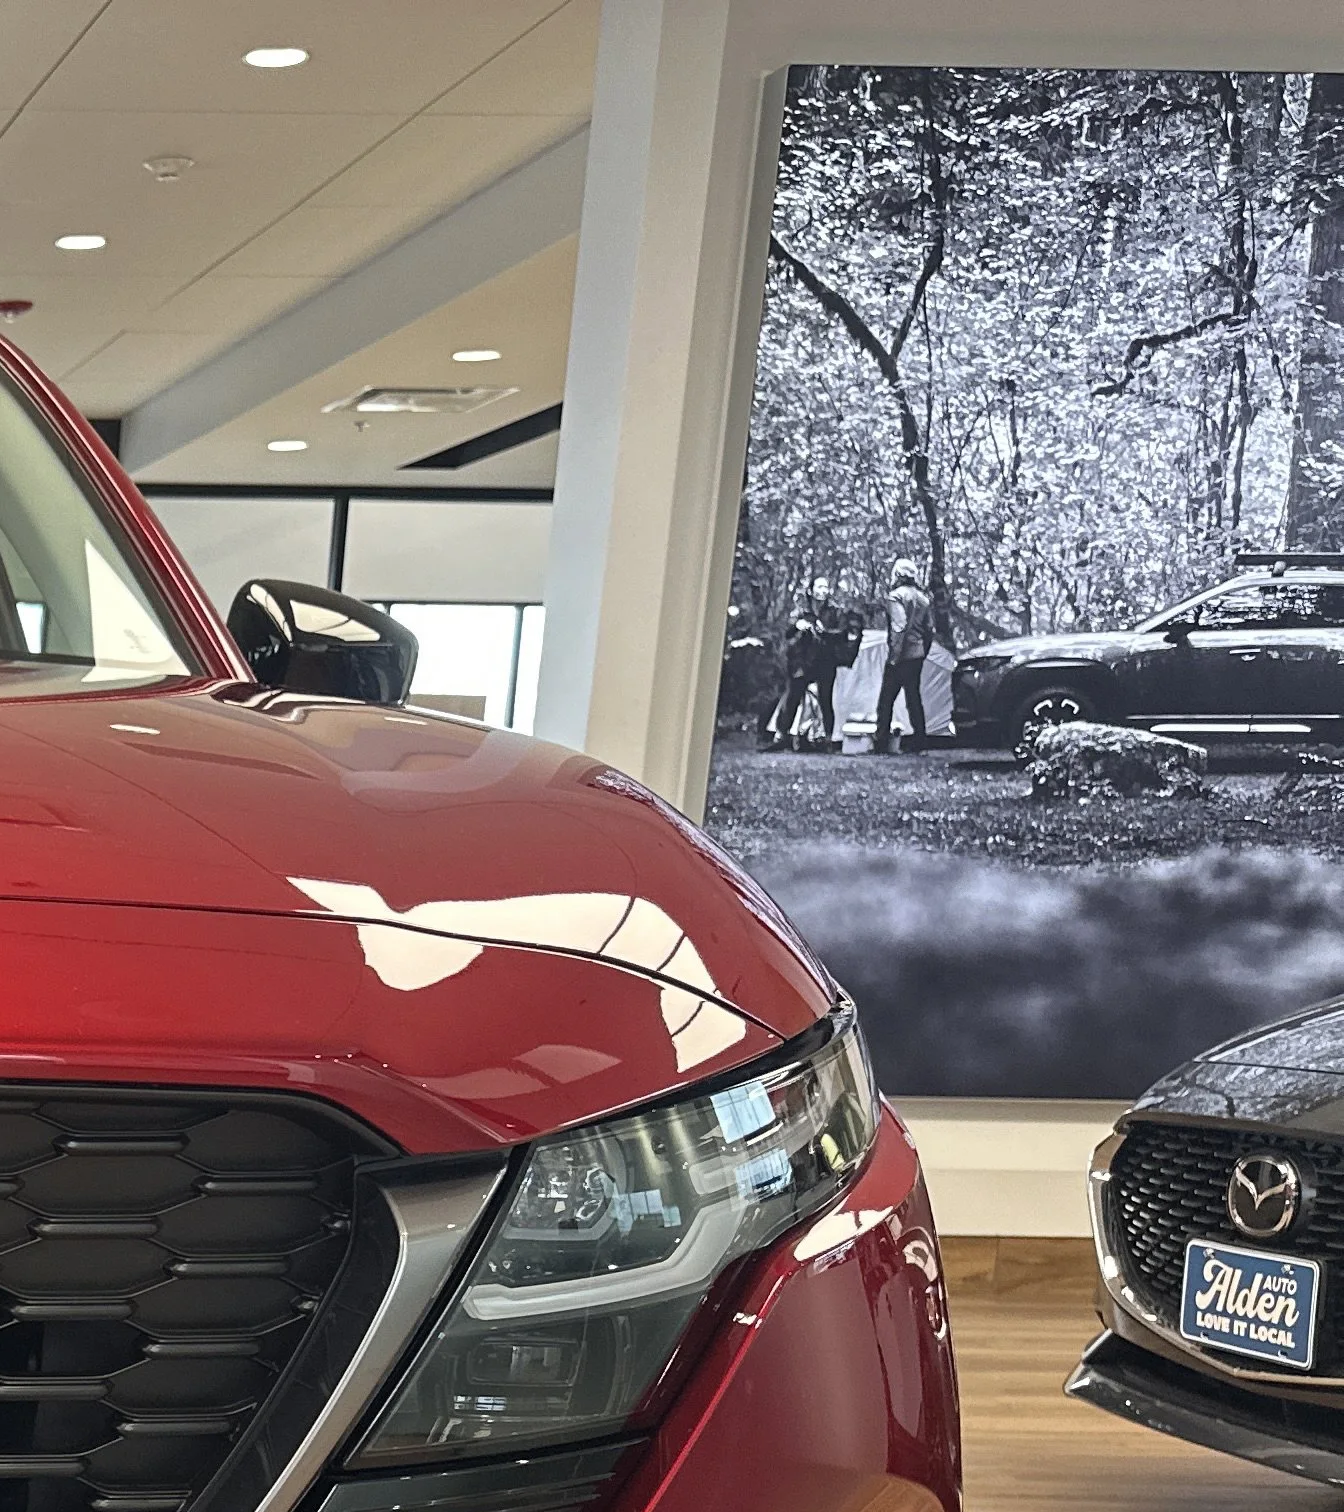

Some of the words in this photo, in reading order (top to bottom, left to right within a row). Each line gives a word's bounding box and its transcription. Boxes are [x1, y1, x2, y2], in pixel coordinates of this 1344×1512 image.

[1195, 1259, 1299, 1327] Alden
[1263, 1275, 1297, 1295] AUTO
[1196, 1311, 1230, 1333] LOVE
[1233, 1319, 1248, 1337] IT
[1249, 1323, 1295, 1348] LOCAL
